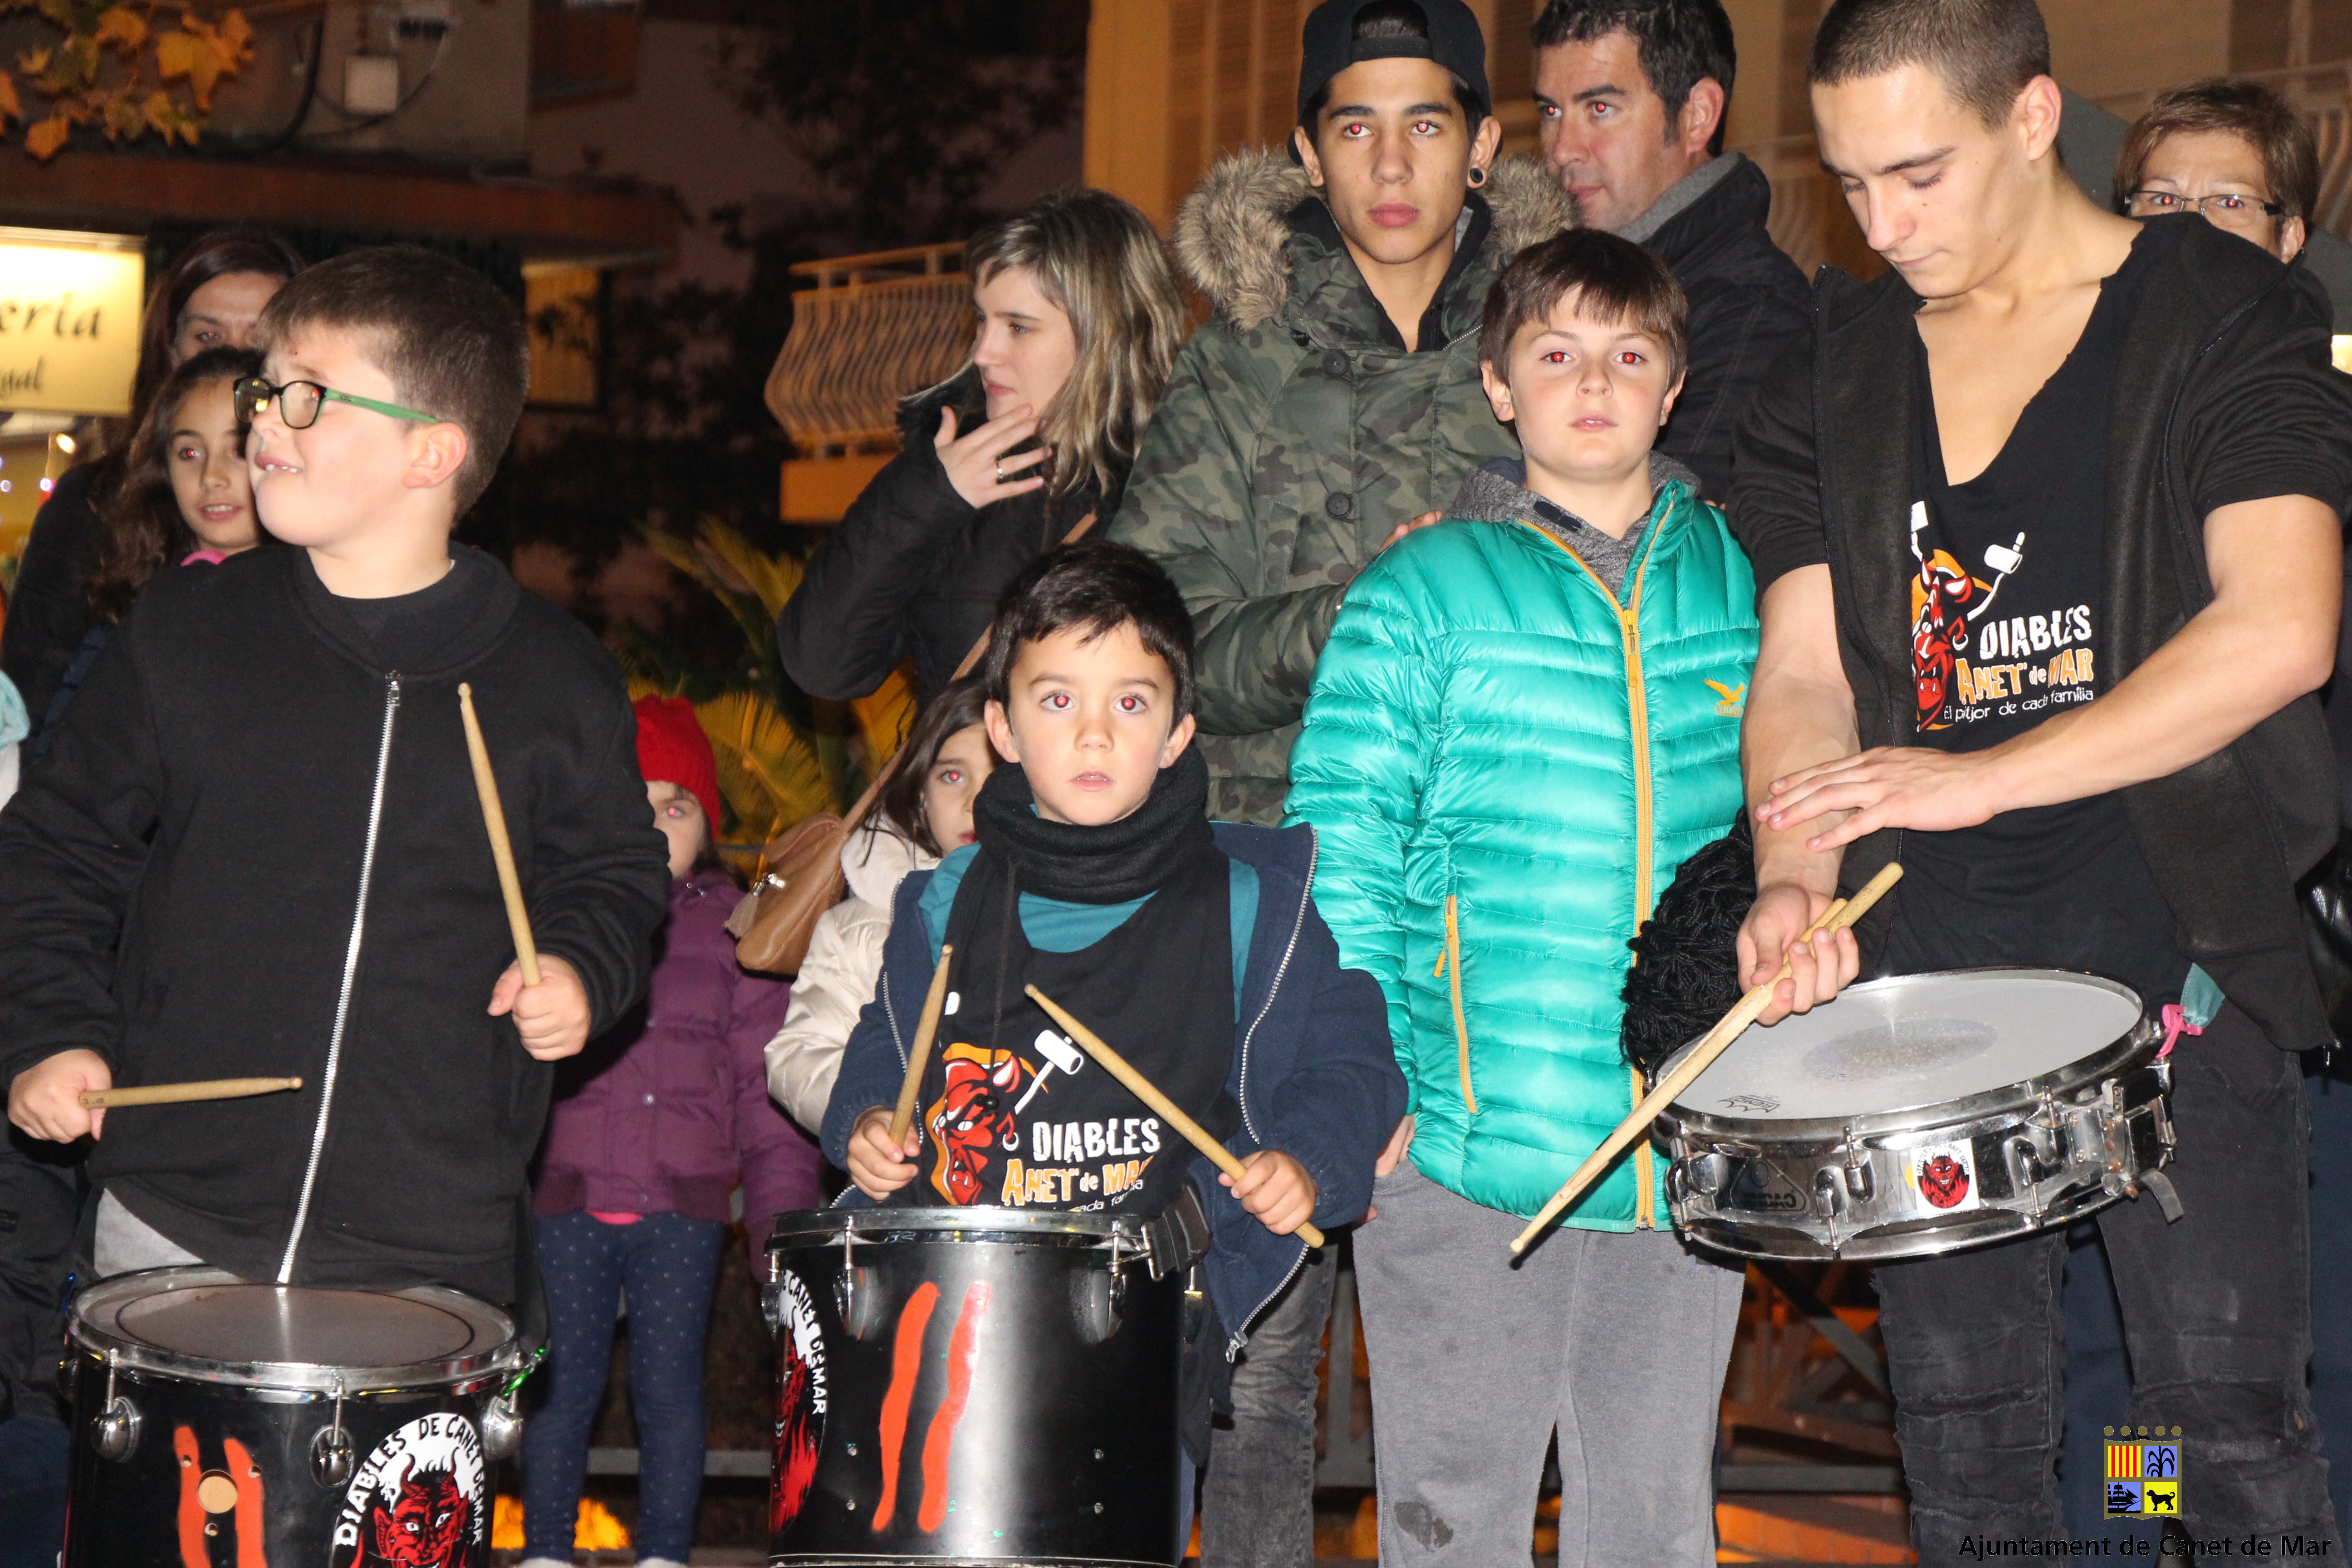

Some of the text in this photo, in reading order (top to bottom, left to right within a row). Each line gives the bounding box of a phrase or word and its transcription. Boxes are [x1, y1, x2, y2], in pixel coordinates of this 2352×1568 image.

[1980, 605, 2092, 660] DIABLES
[2029, 666, 2046, 686] de
[2048, 648, 2093, 688] MAR
[1944, 706, 1952, 720] El
[1955, 706, 1991, 723] pitjor
[1999, 701, 2017, 715] de
[2050, 686, 2094, 703] familia
[1032, 1118, 1160, 1163] DIABLES
[1080, 1172, 1098, 1192] de
[1916, 1148, 1931, 1176] DIABLES
[788, 1274, 817, 1330] CANET
[334, 1430, 407, 1546] DIABLES
[418, 1416, 441, 1441] DE
[446, 1415, 480, 1467] CANET
